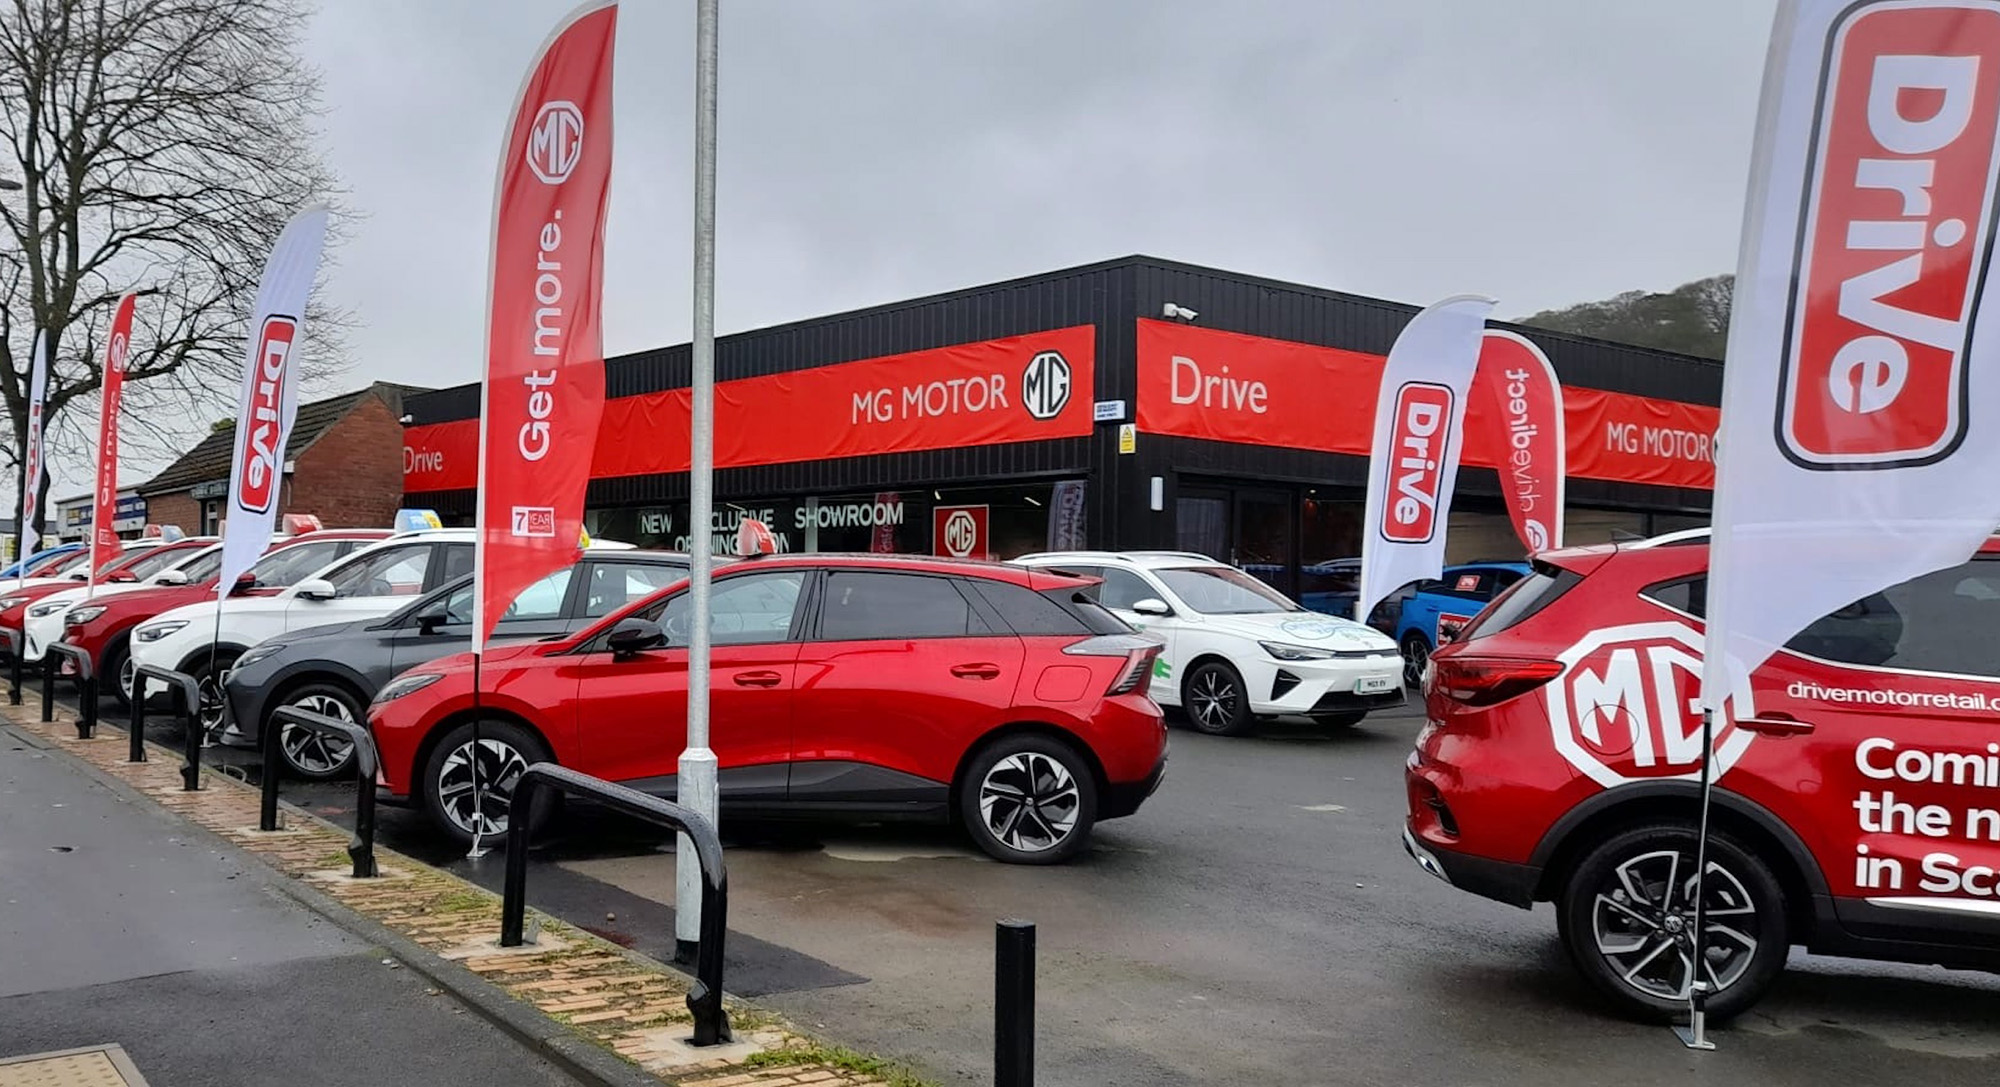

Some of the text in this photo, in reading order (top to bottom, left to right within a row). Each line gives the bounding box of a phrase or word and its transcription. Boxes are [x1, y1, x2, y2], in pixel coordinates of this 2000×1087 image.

[519, 209, 562, 461] Get more.
[852, 374, 1009, 425] MG MOTOR
[1025, 355, 1068, 415] MG
[1171, 355, 1268, 414] Drive
[402, 445, 443, 474] Drive
[1607, 421, 1711, 462] MG MOTOR
[515, 511, 526, 531] 7
[641, 514, 673, 533] NEW
[794, 502, 904, 529] SHOWROOM
[948, 515, 973, 553] MG
[1852, 790, 1952, 837] the
[1855, 843, 1903, 890] in
